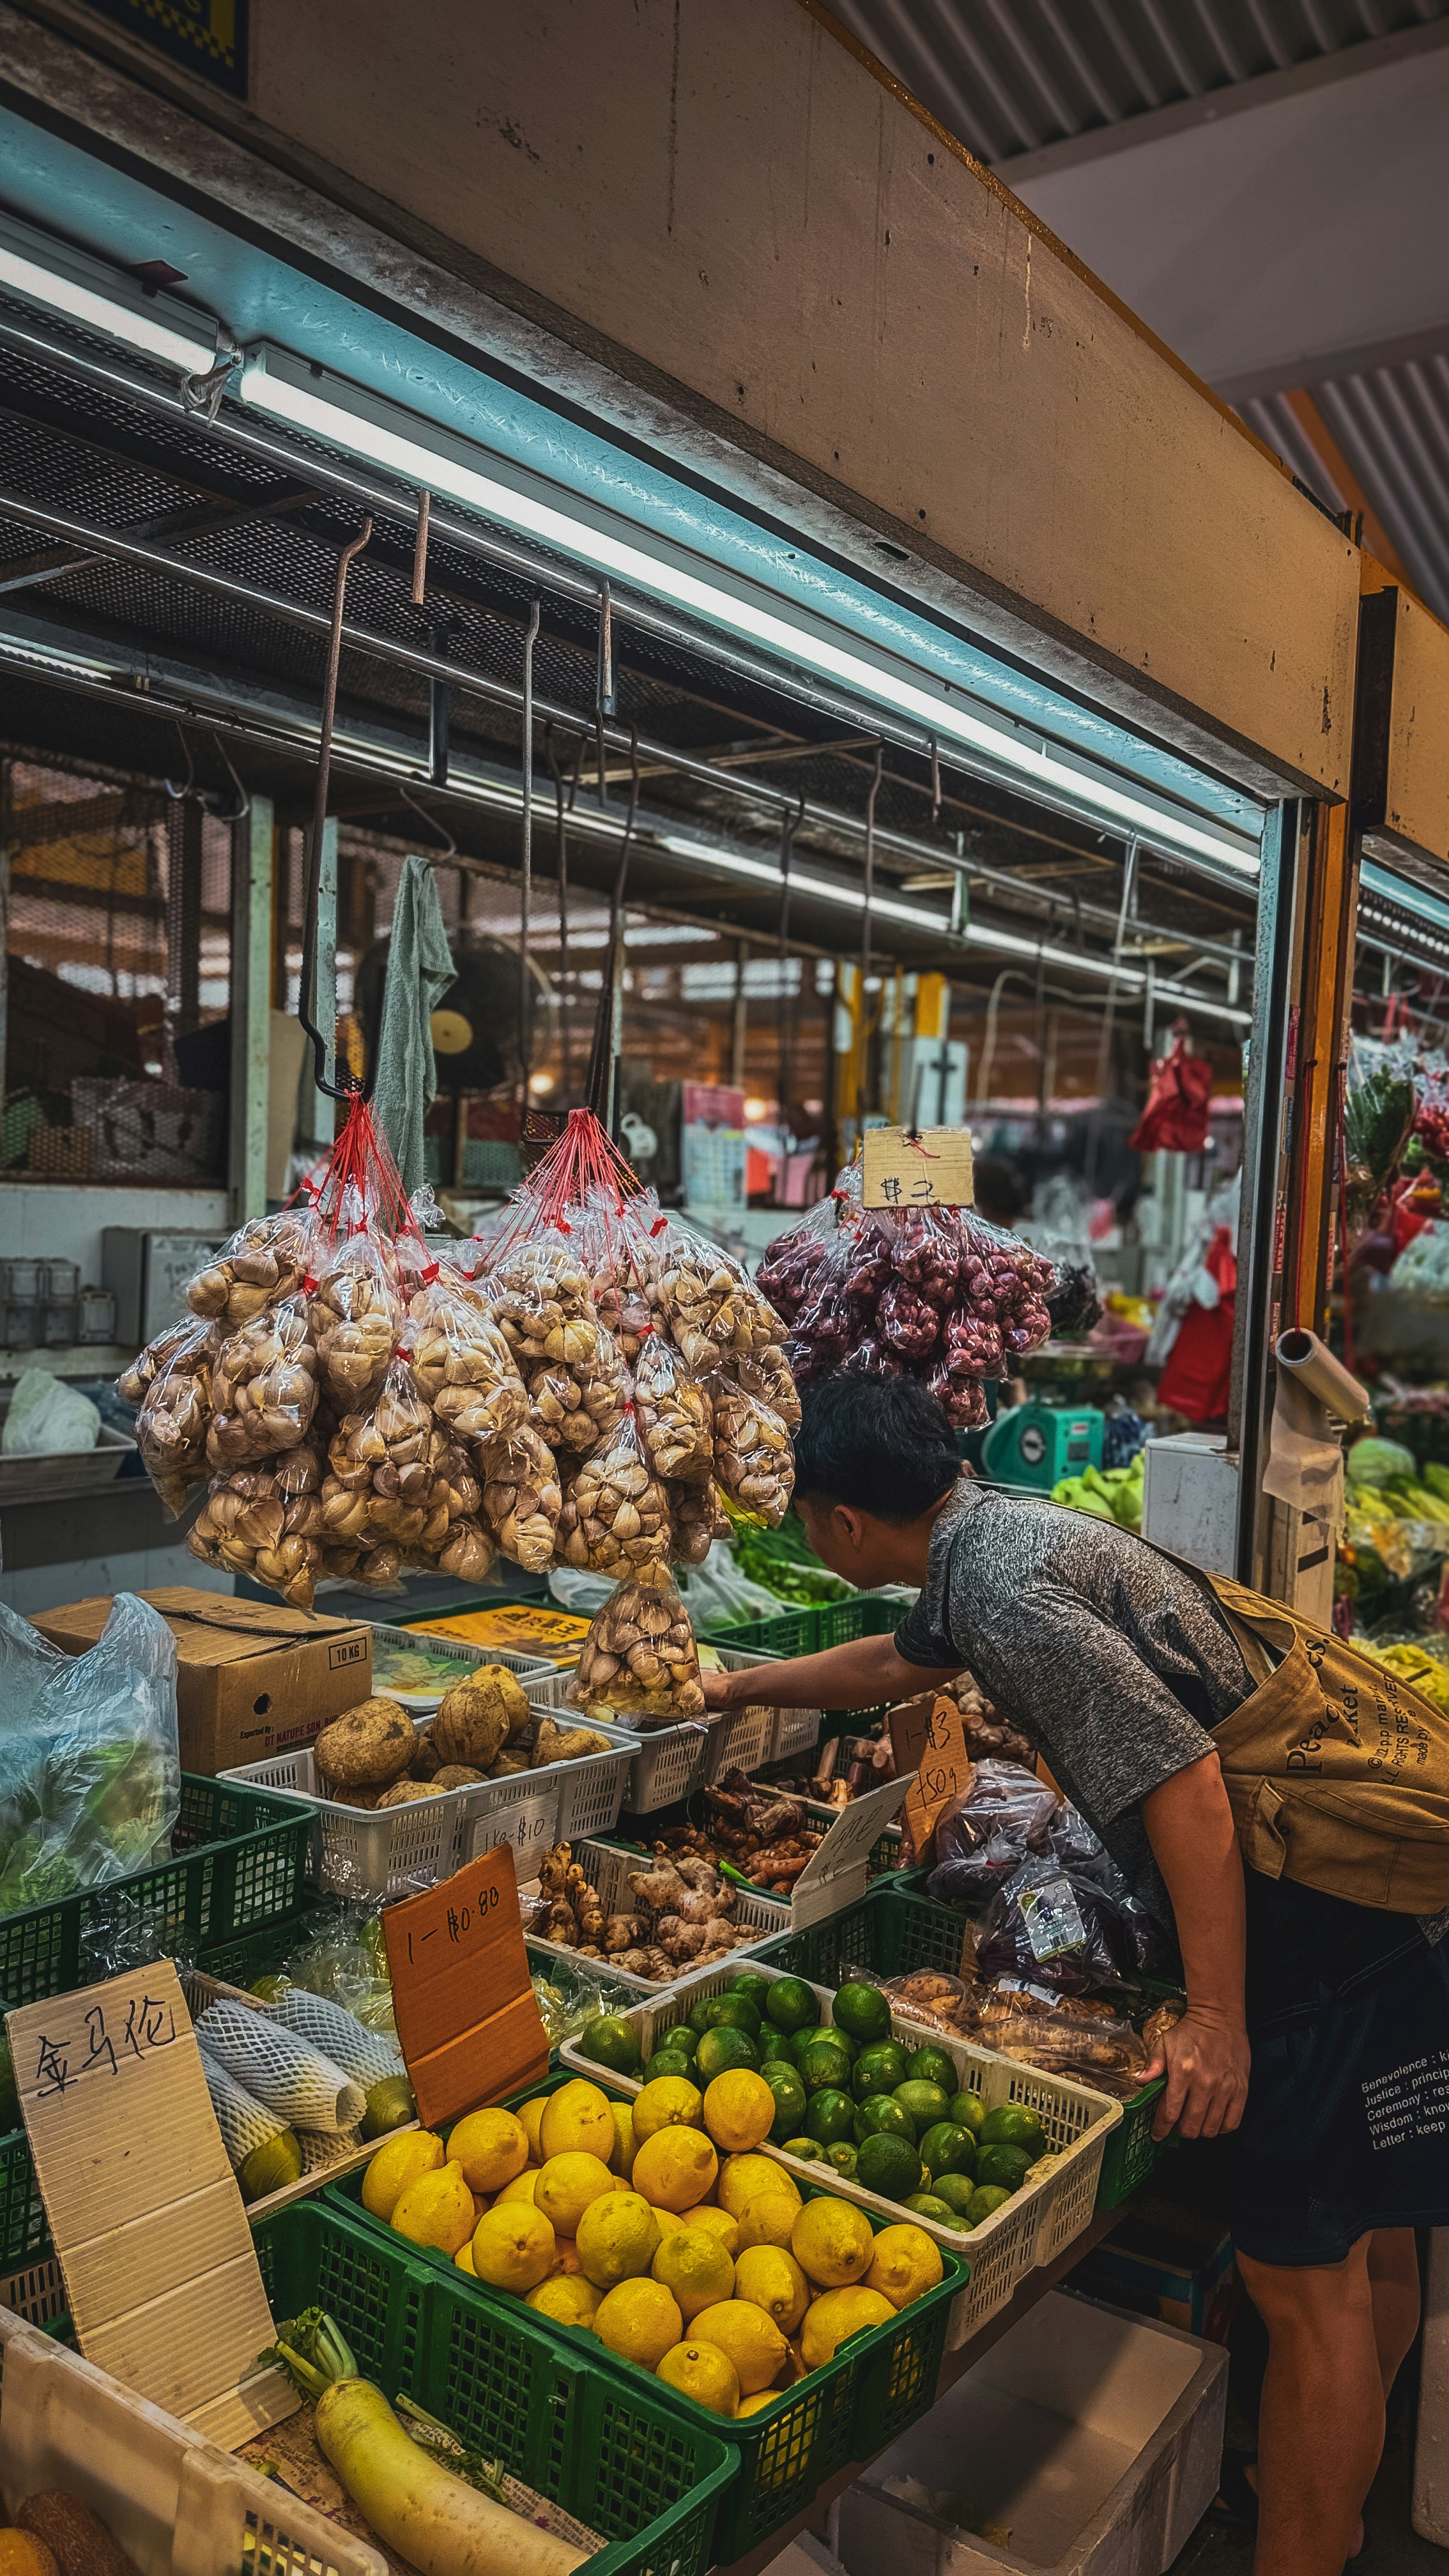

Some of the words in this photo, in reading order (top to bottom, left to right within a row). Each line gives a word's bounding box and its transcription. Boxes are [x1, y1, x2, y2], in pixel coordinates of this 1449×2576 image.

[336, 1648, 347, 1663] 10
[348, 1643, 360, 1660] KG
[276, 1725, 304, 1744] NATURE
[1361, 2058, 1427, 2093] Benevolence
[1365, 2085, 1402, 2108] Justice
[1367, 2094, 1420, 2121] Ceremony
[1369, 2113, 1413, 2135] Wisdom
[1372, 2132, 1406, 2150] Letter
[1416, 2121, 1446, 2135] keep
